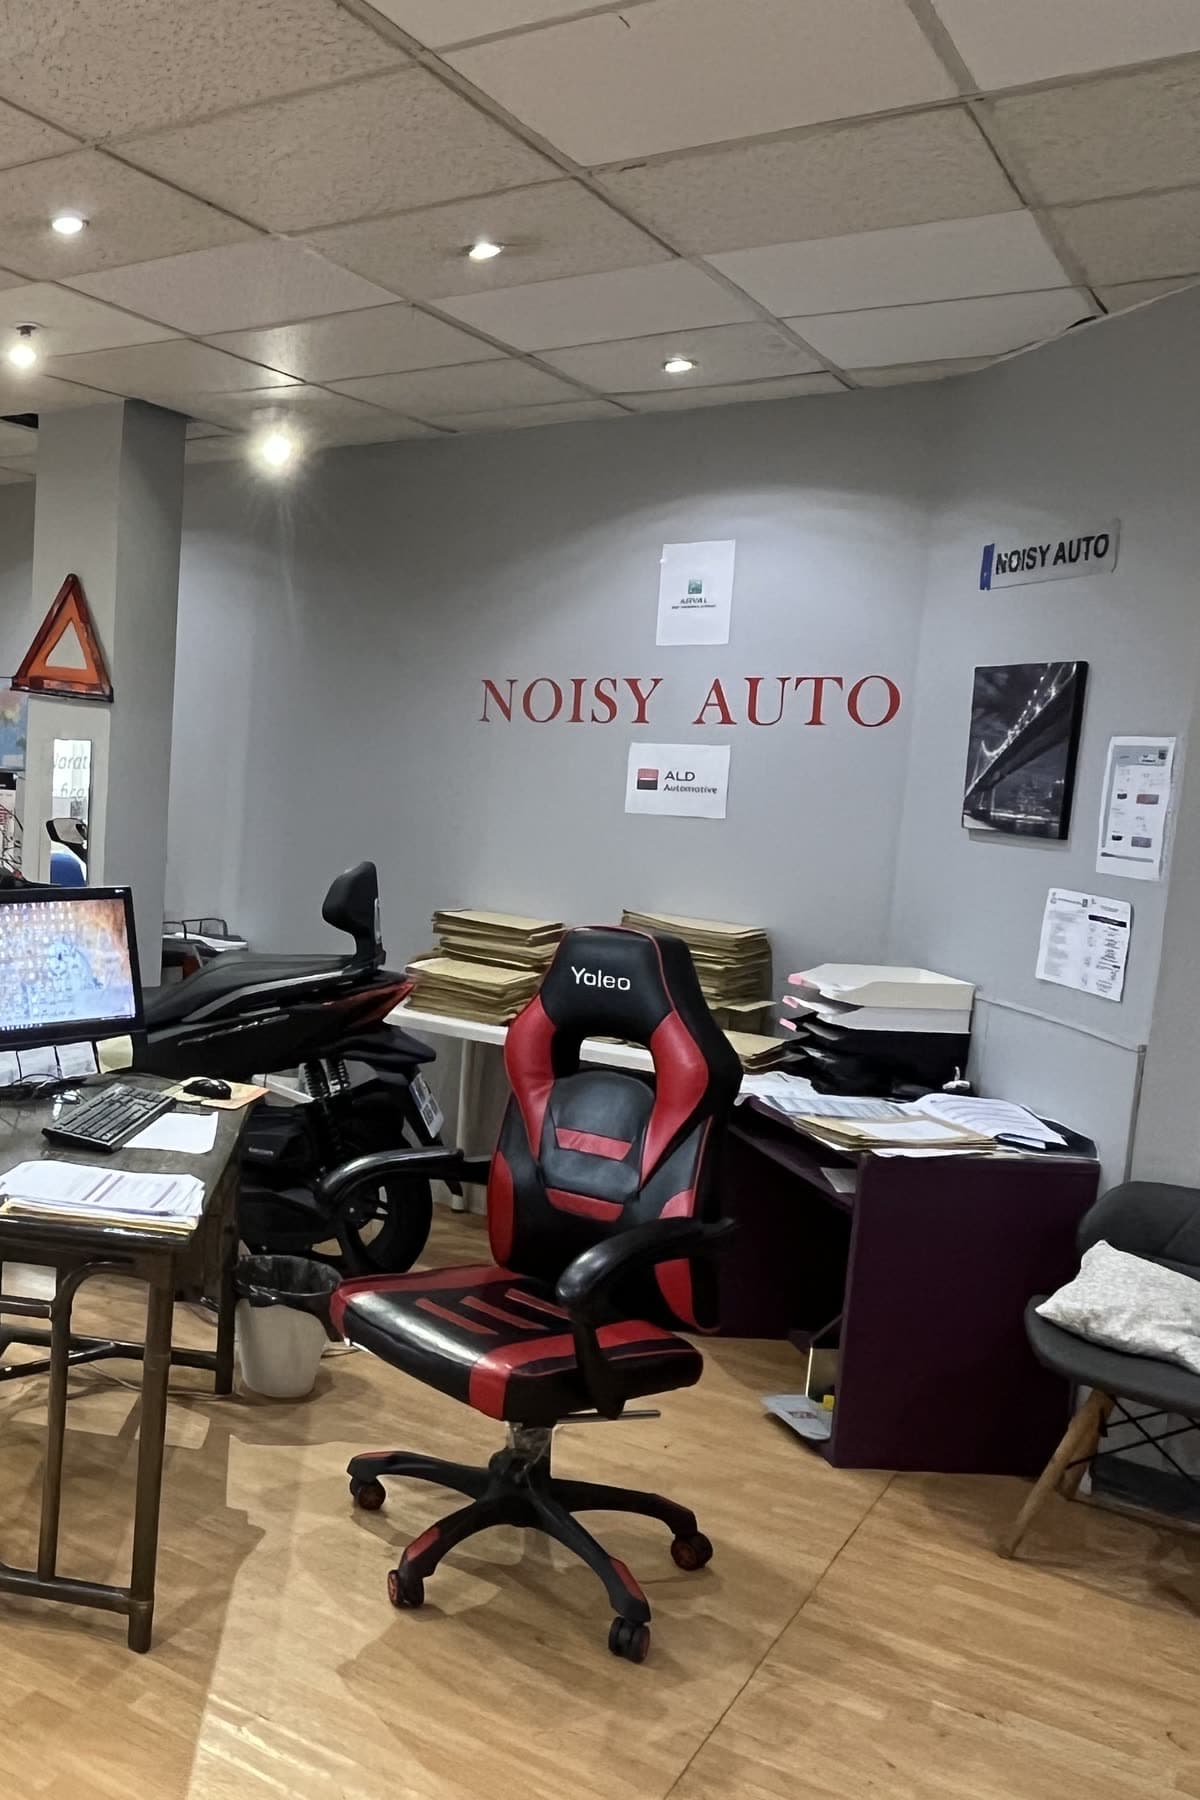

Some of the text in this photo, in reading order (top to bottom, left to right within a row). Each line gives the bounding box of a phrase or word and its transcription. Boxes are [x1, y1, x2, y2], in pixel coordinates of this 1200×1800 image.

[995, 534, 1109, 575] NOISY AUTO
[478, 675, 901, 727] NOISY AUTO
[663, 783, 718, 794] Automotive
[664, 770, 696, 782] ALD
